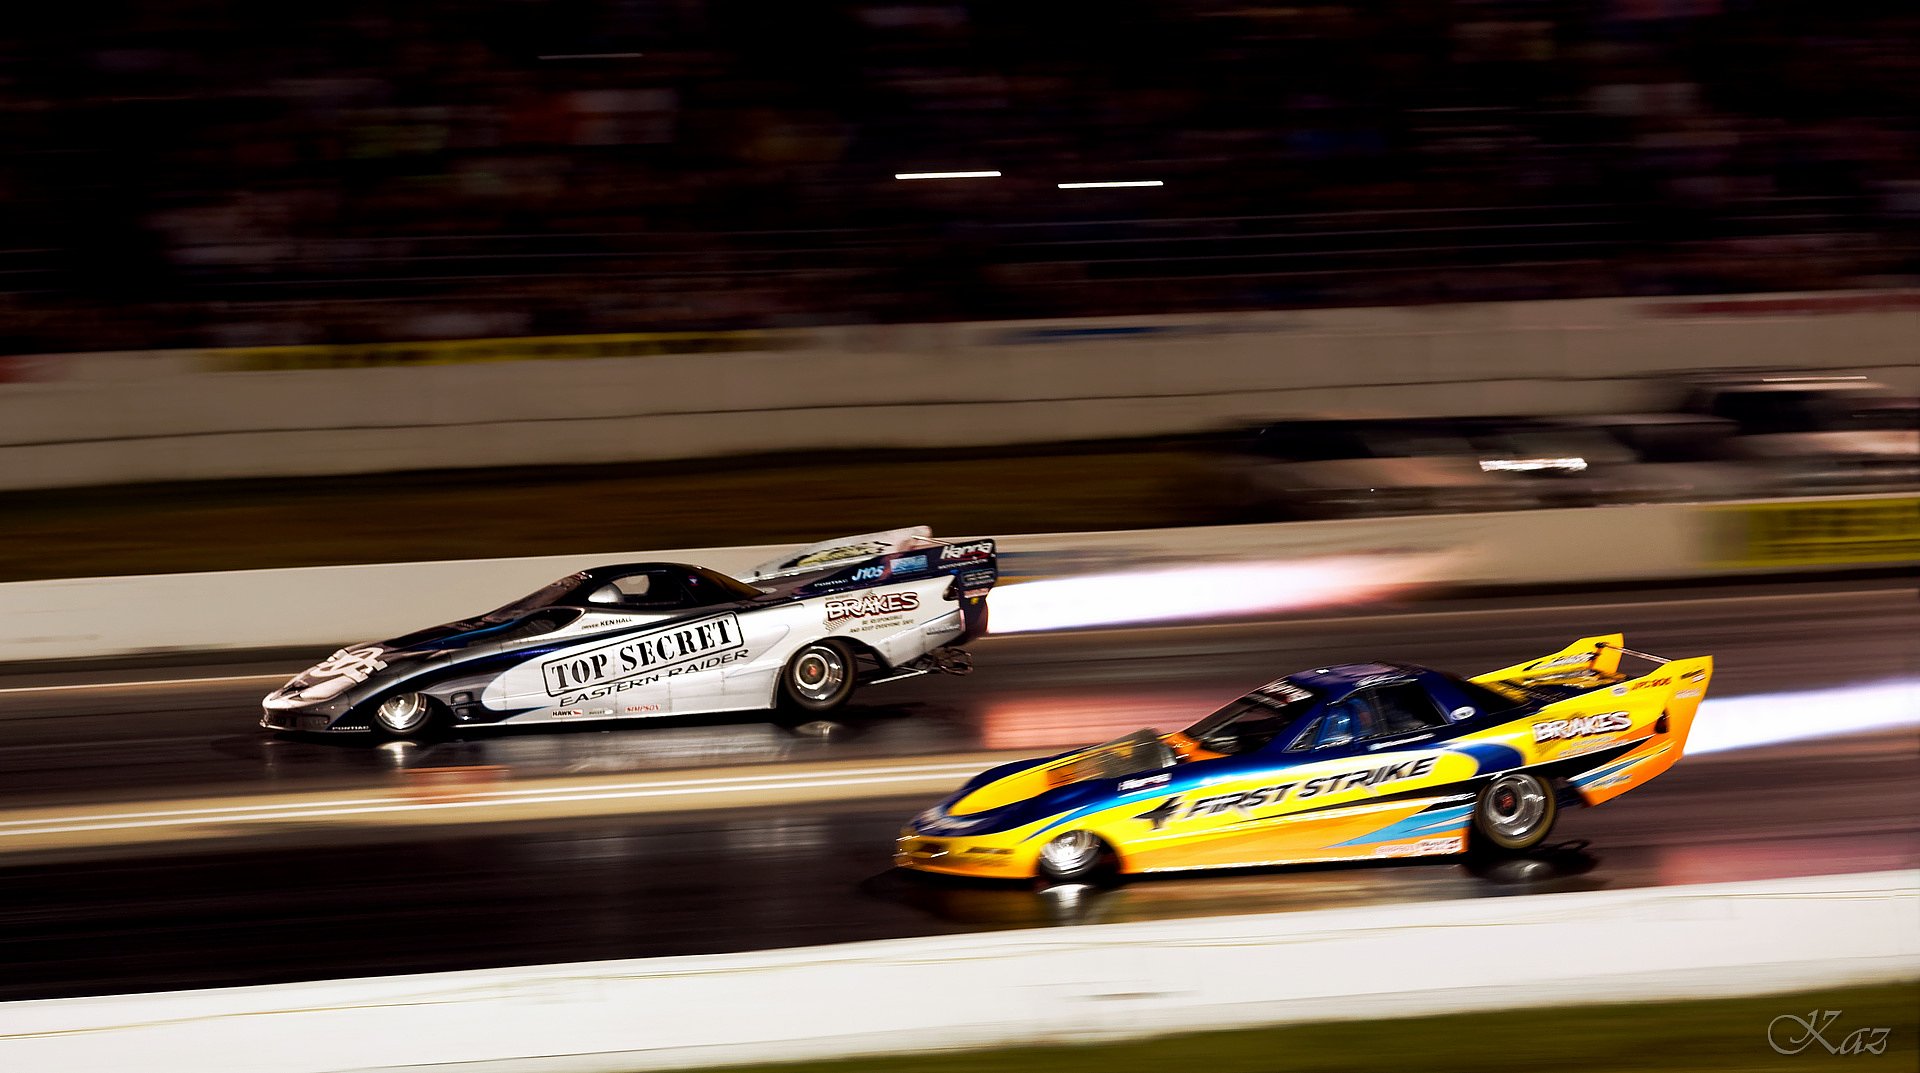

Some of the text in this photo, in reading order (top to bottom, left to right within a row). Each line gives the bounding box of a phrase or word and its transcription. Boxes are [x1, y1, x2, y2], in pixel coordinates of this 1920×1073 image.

[851, 565, 885, 581] J105
[600, 619, 615, 627] KEN
[616, 616, 632, 624] HALL
[825, 592, 920, 621] BRAKES
[551, 619, 732, 690] TOP SECRET
[559, 648, 749, 708] EASTERN RAIDER
[1532, 711, 1633, 742] BRAKES
[1185, 755, 1441, 820] FIRST STRIKE
